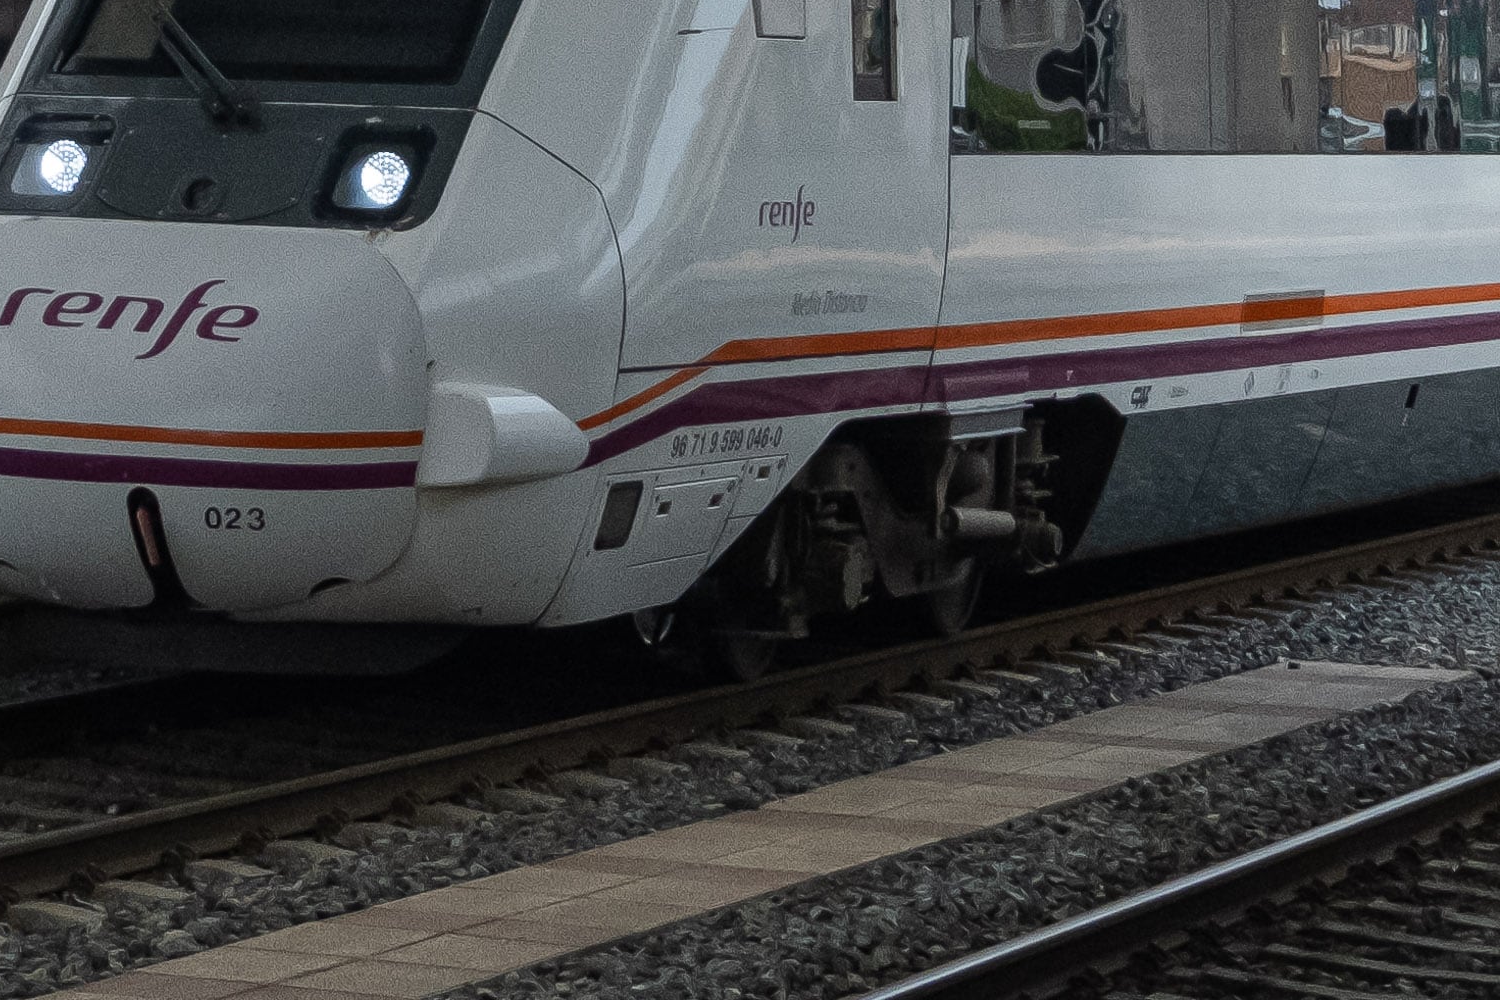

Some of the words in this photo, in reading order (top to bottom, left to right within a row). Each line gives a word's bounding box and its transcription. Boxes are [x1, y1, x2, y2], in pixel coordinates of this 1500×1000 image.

[758, 184, 815, 244] renfe
[691, 432, 707, 455] 71
[204, 506, 266, 531] 023
